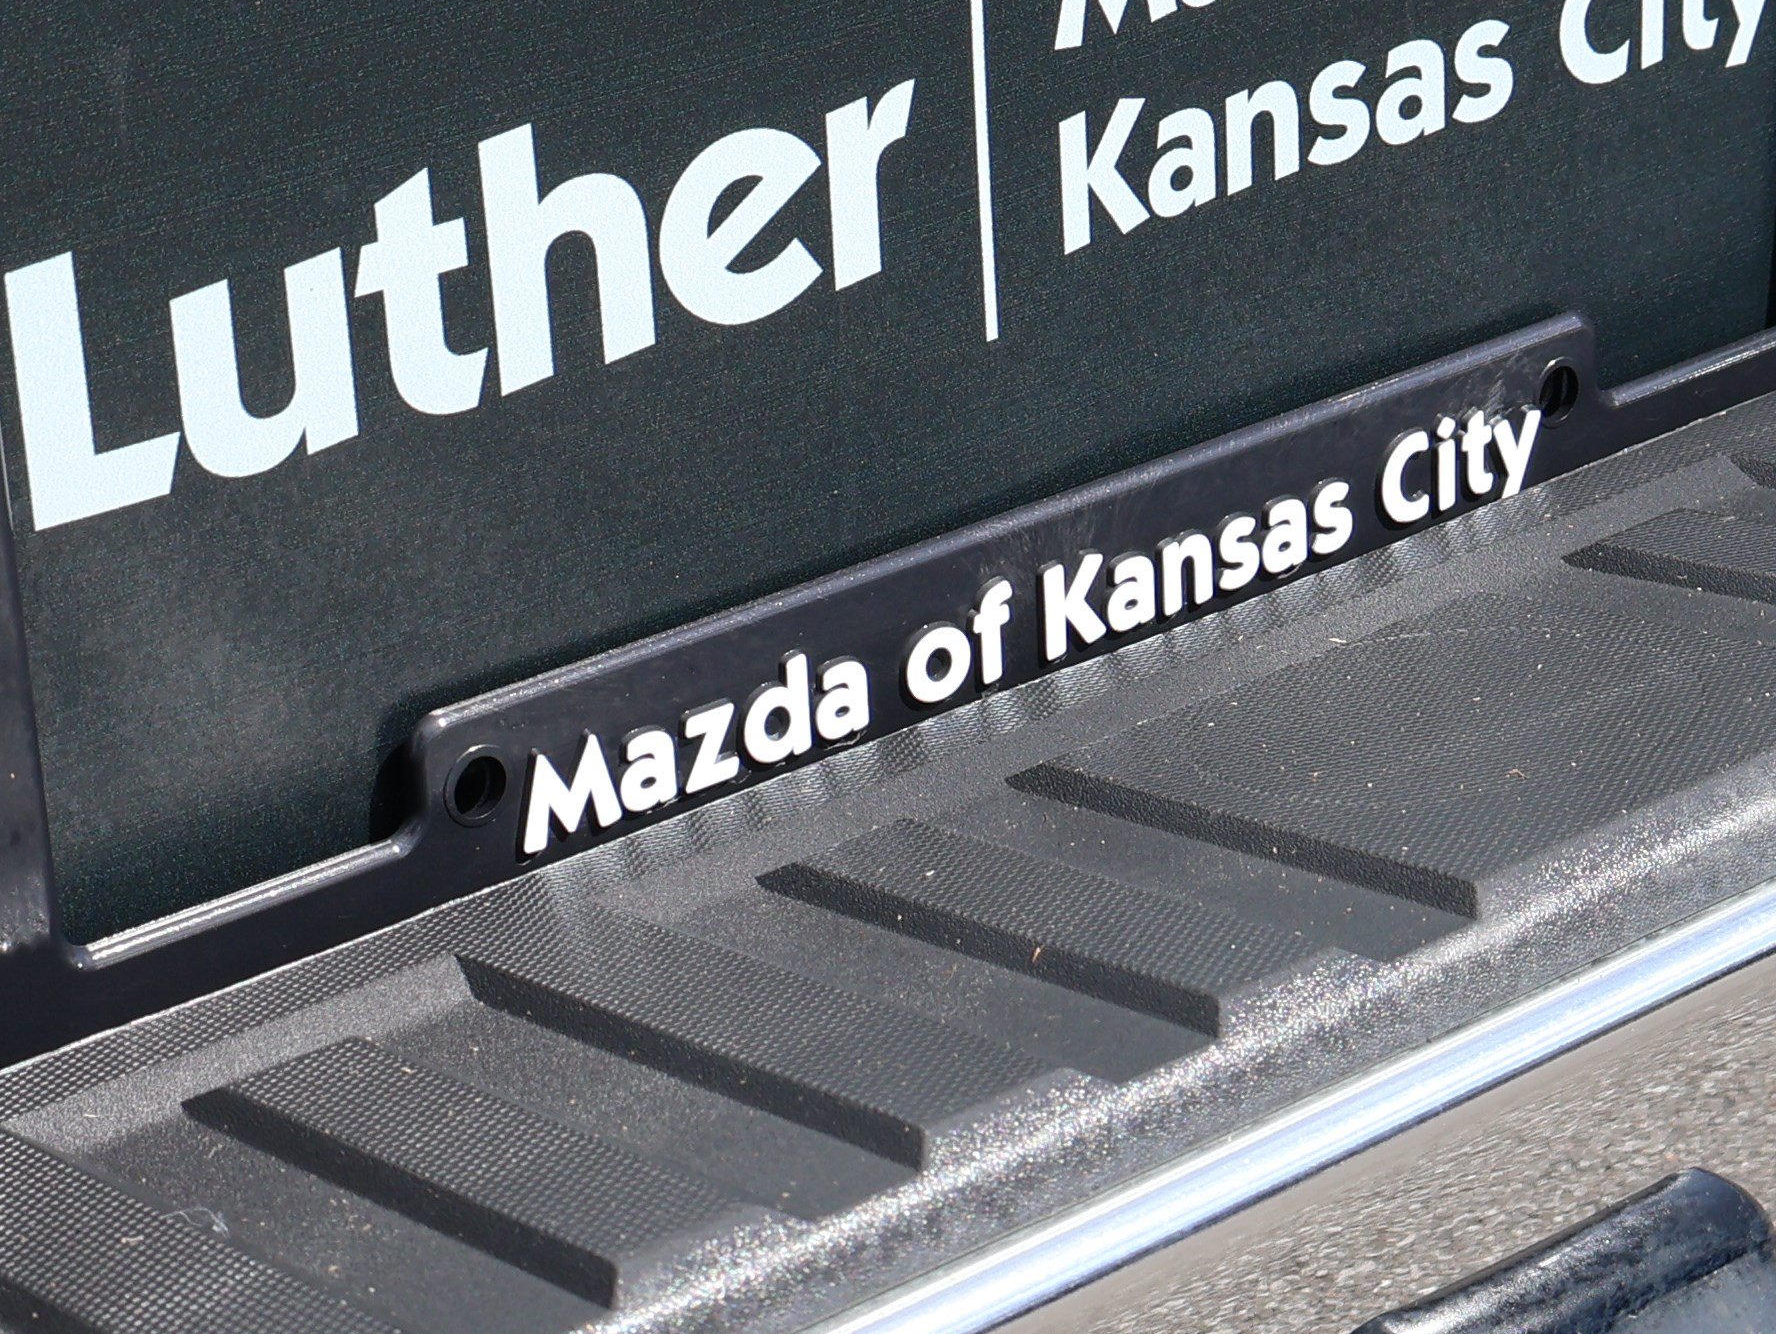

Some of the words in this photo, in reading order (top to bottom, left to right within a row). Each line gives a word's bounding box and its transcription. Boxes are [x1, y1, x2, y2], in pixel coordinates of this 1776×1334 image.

[3, 77, 916, 533] Luther
[1057, 18, 1515, 256] Kansas
[522, 652, 871, 855] Mazda
[905, 578, 1014, 704] of
[1042, 480, 1354, 662] Kansas
[1381, 408, 1543, 524] City
